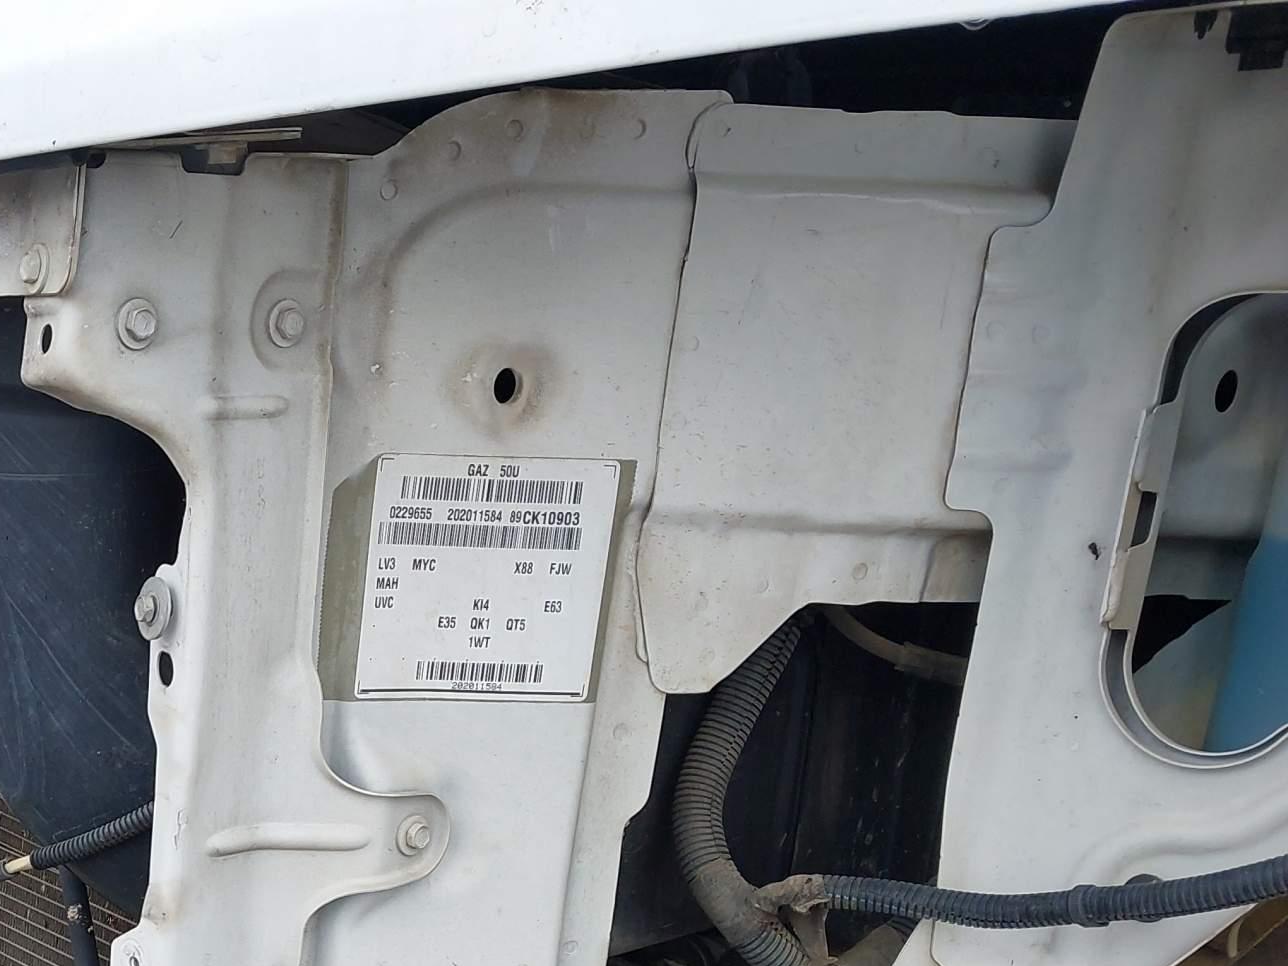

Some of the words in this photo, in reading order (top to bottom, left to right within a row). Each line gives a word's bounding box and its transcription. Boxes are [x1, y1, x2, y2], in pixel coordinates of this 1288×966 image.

[468, 464, 489, 476] GAZ
[500, 465, 520, 478] 50U
[390, 506, 432, 520] 0229655
[447, 509, 502, 522] 202011584
[379, 558, 395, 570] LV3
[412, 559, 436, 571] MYC
[514, 562, 533, 574] X88
[550, 563, 571, 575] FJW
[376, 577, 398, 589] MAH
[375, 596, 393, 608] UVC
[544, 601, 561, 612] E63
[438, 616, 456, 628] E35
[506, 619, 525, 631] QT5
[468, 636, 491, 649] 1WT
[451, 681, 503, 691] 202011584
